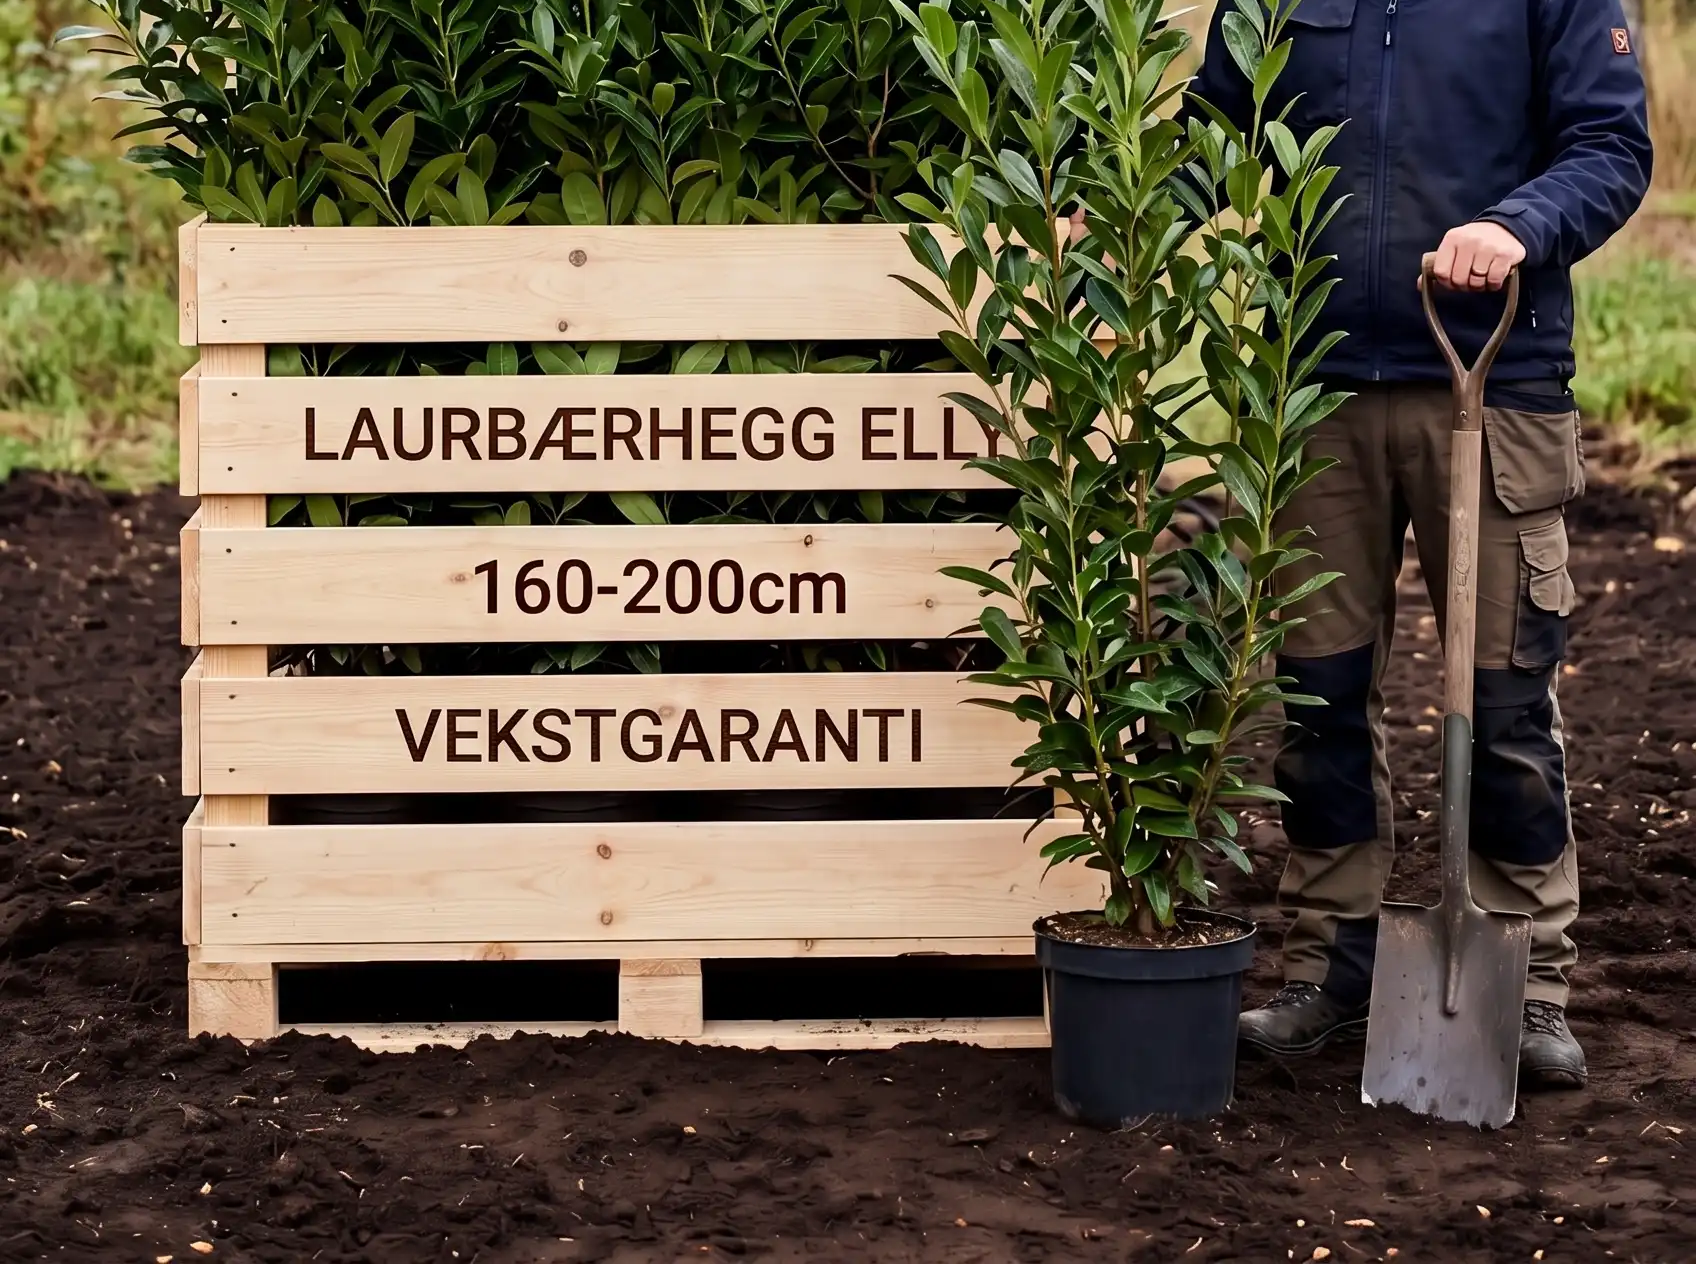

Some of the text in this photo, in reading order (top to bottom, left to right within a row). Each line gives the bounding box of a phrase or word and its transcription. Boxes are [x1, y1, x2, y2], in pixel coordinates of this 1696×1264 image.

[305, 406, 835, 462] LAURBÆRHEGG
[474, 558, 846, 615] 160-200cm
[394, 708, 922, 763] VEKSTGARANTI
